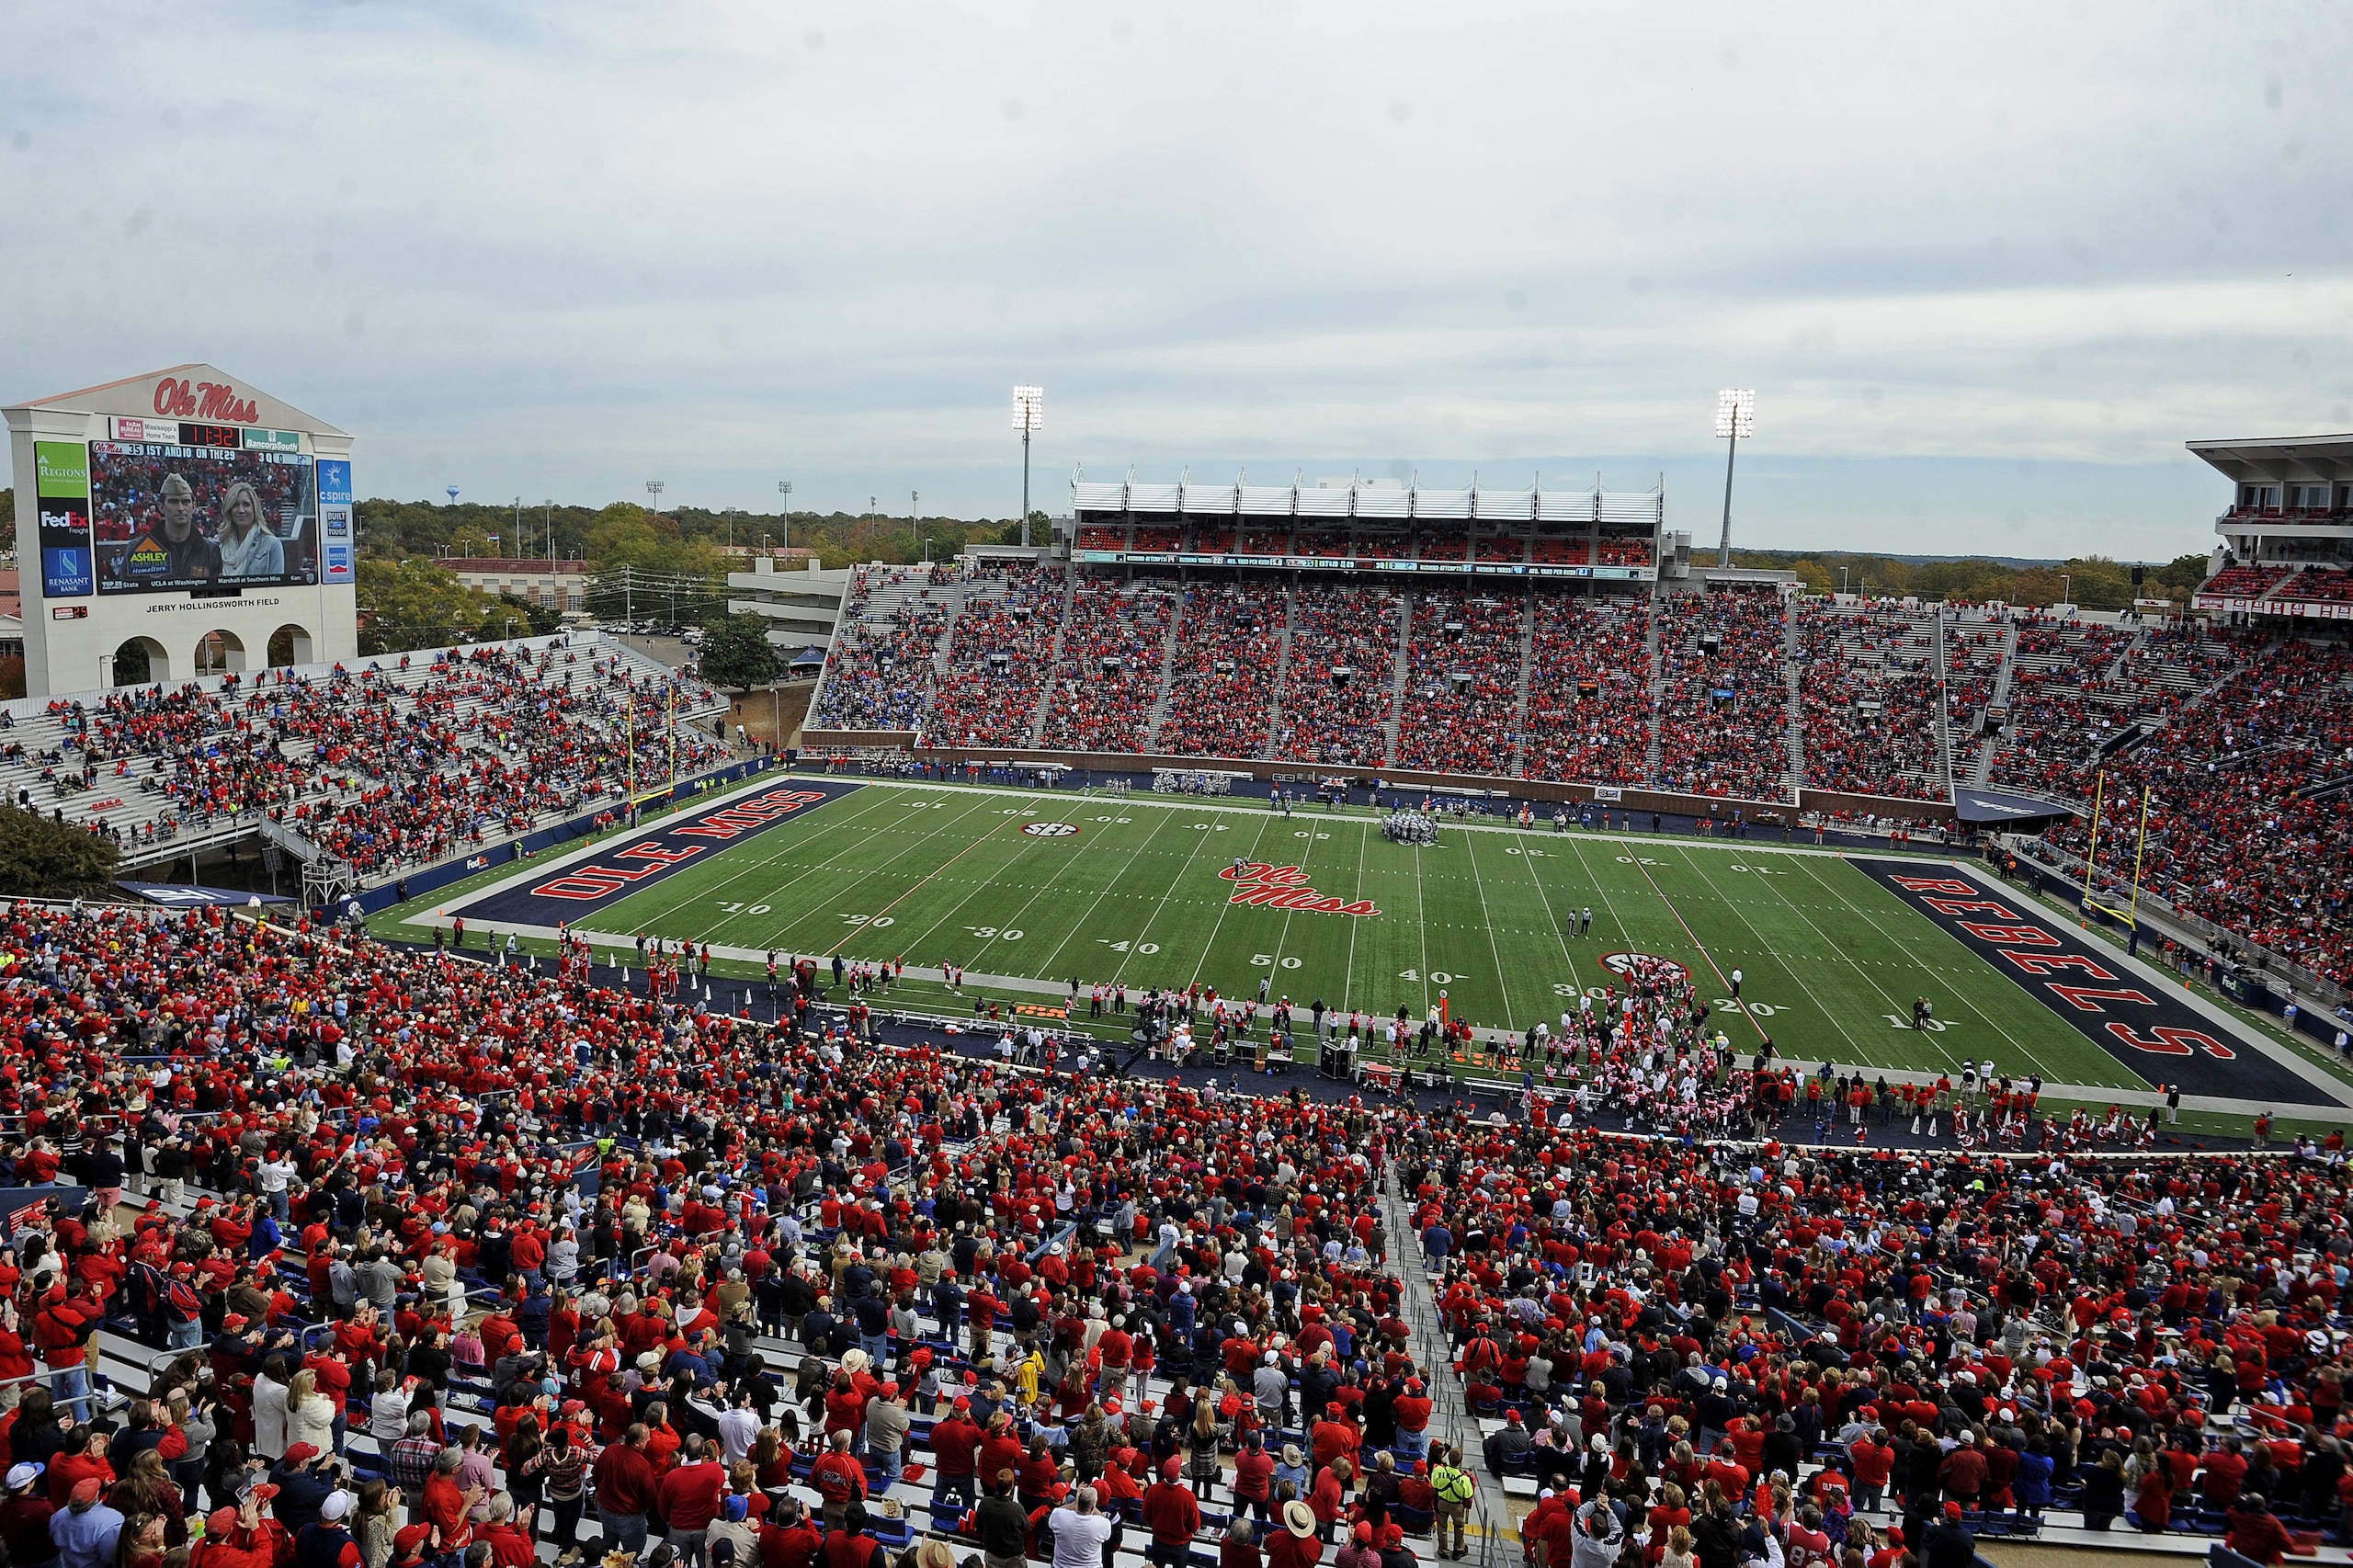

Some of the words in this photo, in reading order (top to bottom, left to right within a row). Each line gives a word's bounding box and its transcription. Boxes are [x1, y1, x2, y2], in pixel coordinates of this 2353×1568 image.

[154, 378, 197, 416] Ole
[197, 381, 259, 423] Miss
[144, 423, 177, 434] Mississippi's
[145, 431, 163, 439] Home
[163, 432, 176, 440] Team
[129, 445, 141, 455] 35
[246, 437, 298, 451] BancorpSouth
[165, 447, 182, 458] AND
[196, 449, 208, 460] ON
[209, 449, 224, 460] THE
[224, 450, 235, 460] 29
[327, 491, 351, 502] spire
[41, 511, 88, 528] FedEx
[328, 512, 346, 520] BUILT
[130, 552, 168, 562] ASHLEY
[49, 577, 89, 585] RENASANT
[174, 579, 208, 587] Washington
[246, 575, 269, 584] Southern
[146, 604, 176, 613] JERRY
[179, 598, 255, 611] HOLLINGSWORTH
[256, 597, 280, 607] FIELD
[668, 789, 826, 839] MISS
[1023, 822, 1078, 837] SEC
[467, 855, 489, 869] FedEx
[530, 841, 708, 901] OLE
[1218, 862, 1311, 885] Ole
[1229, 882, 1382, 916] Miss
[842, 914, 895, 927] 20
[973, 926, 1025, 941] 30
[1108, 939, 1160, 955] 40
[1250, 953, 1302, 970] 50
[1888, 874, 2237, 1061] REBELS
[1397, 969, 1453, 984] 40
[1711, 998, 1777, 1017] 20
[1438, 1471, 1465, 1487] VENDOR
